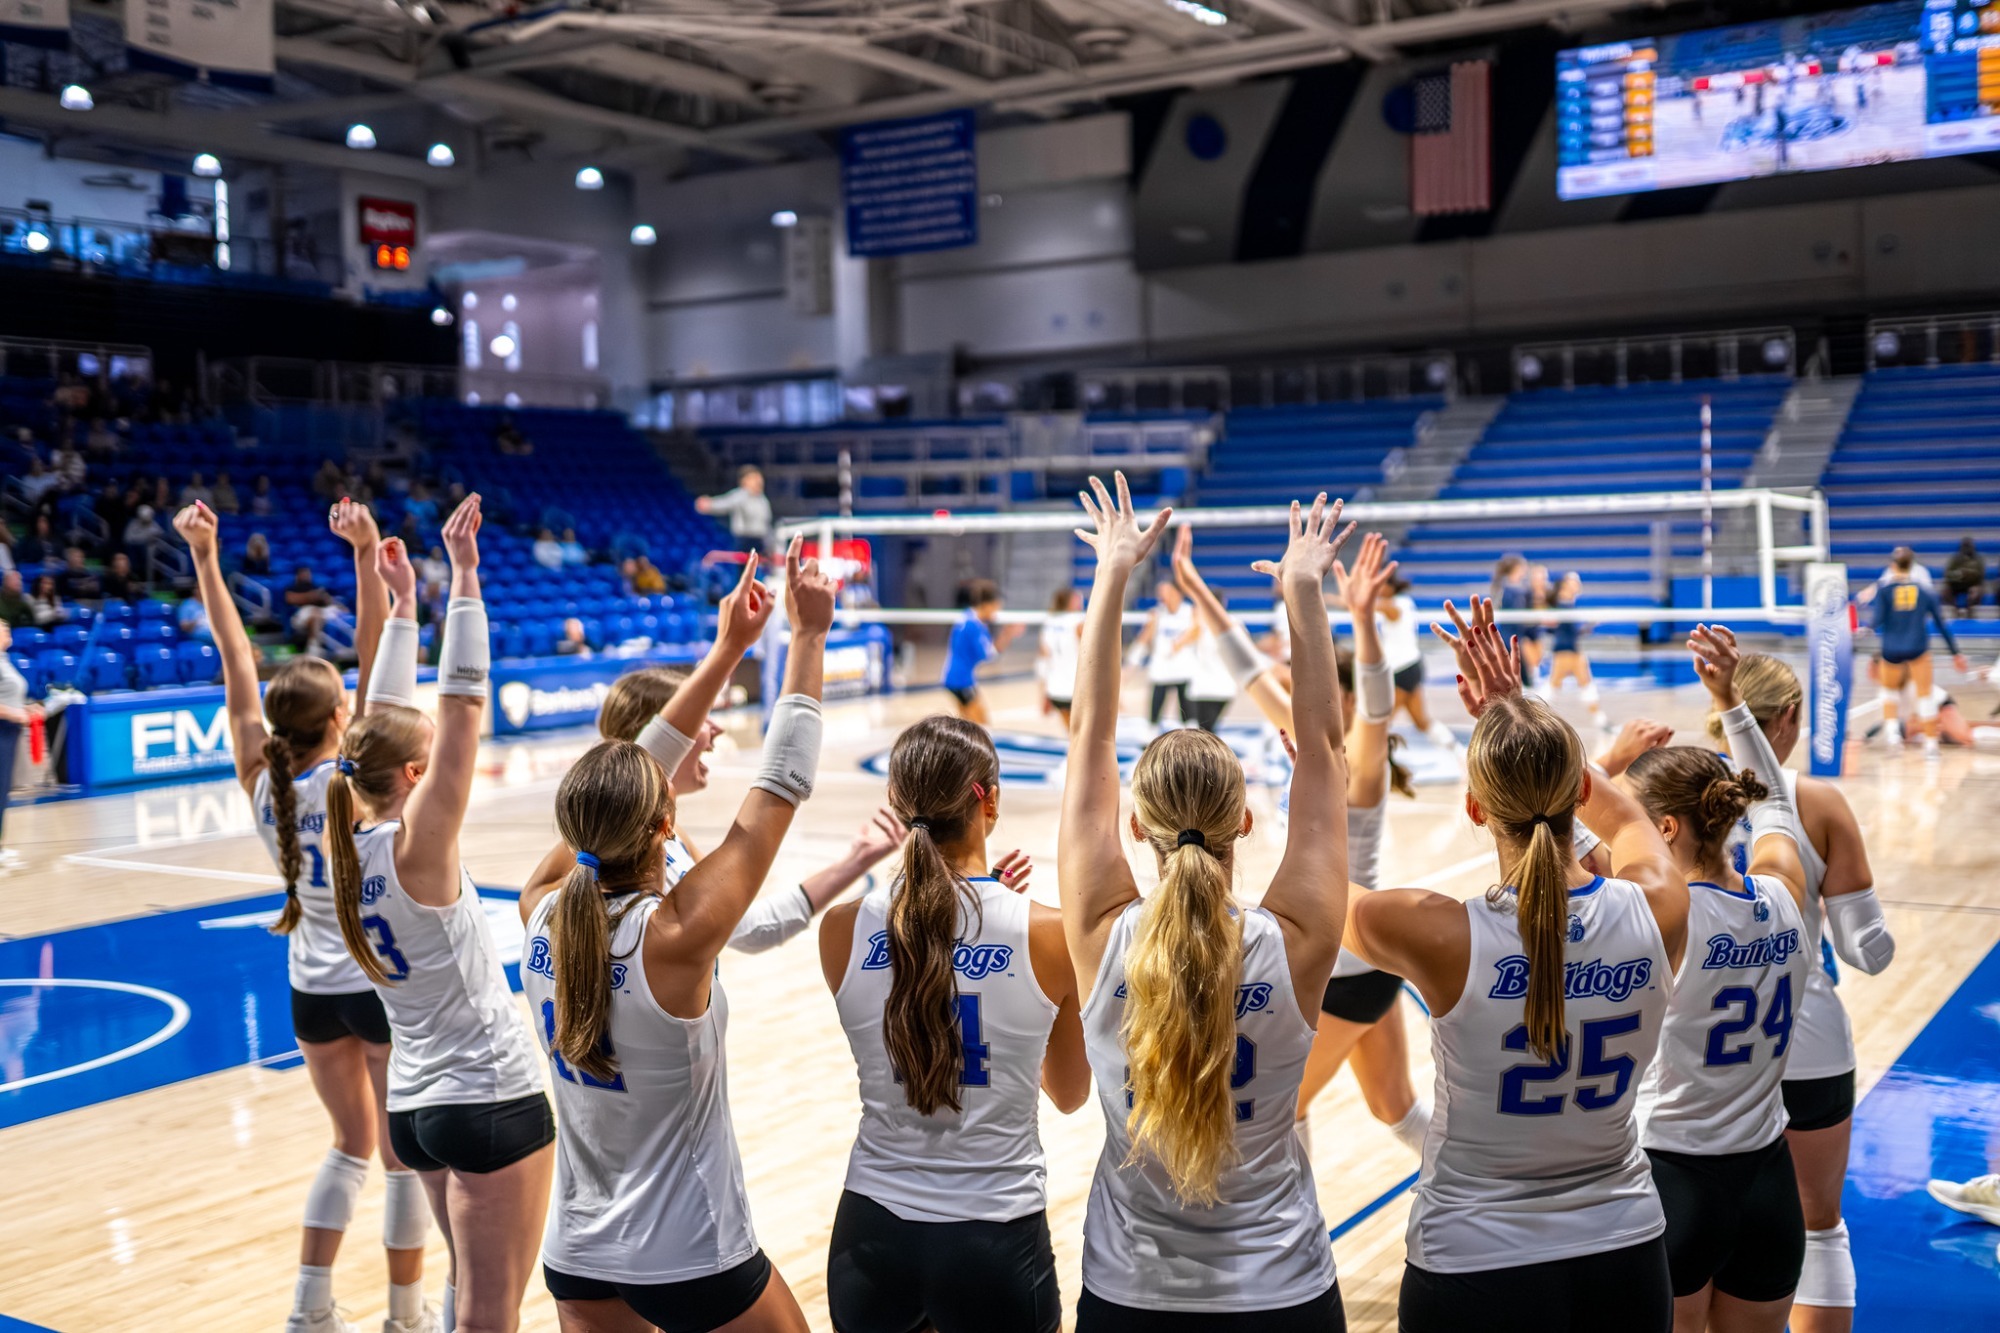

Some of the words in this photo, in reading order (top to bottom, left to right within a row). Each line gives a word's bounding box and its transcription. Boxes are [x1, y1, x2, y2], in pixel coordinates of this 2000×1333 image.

[861, 930, 1014, 980] Bogs
[1488, 954, 1653, 1003] Bldogs
[1703, 971, 1793, 1068] 24
[1496, 1009, 1643, 1118] 25
